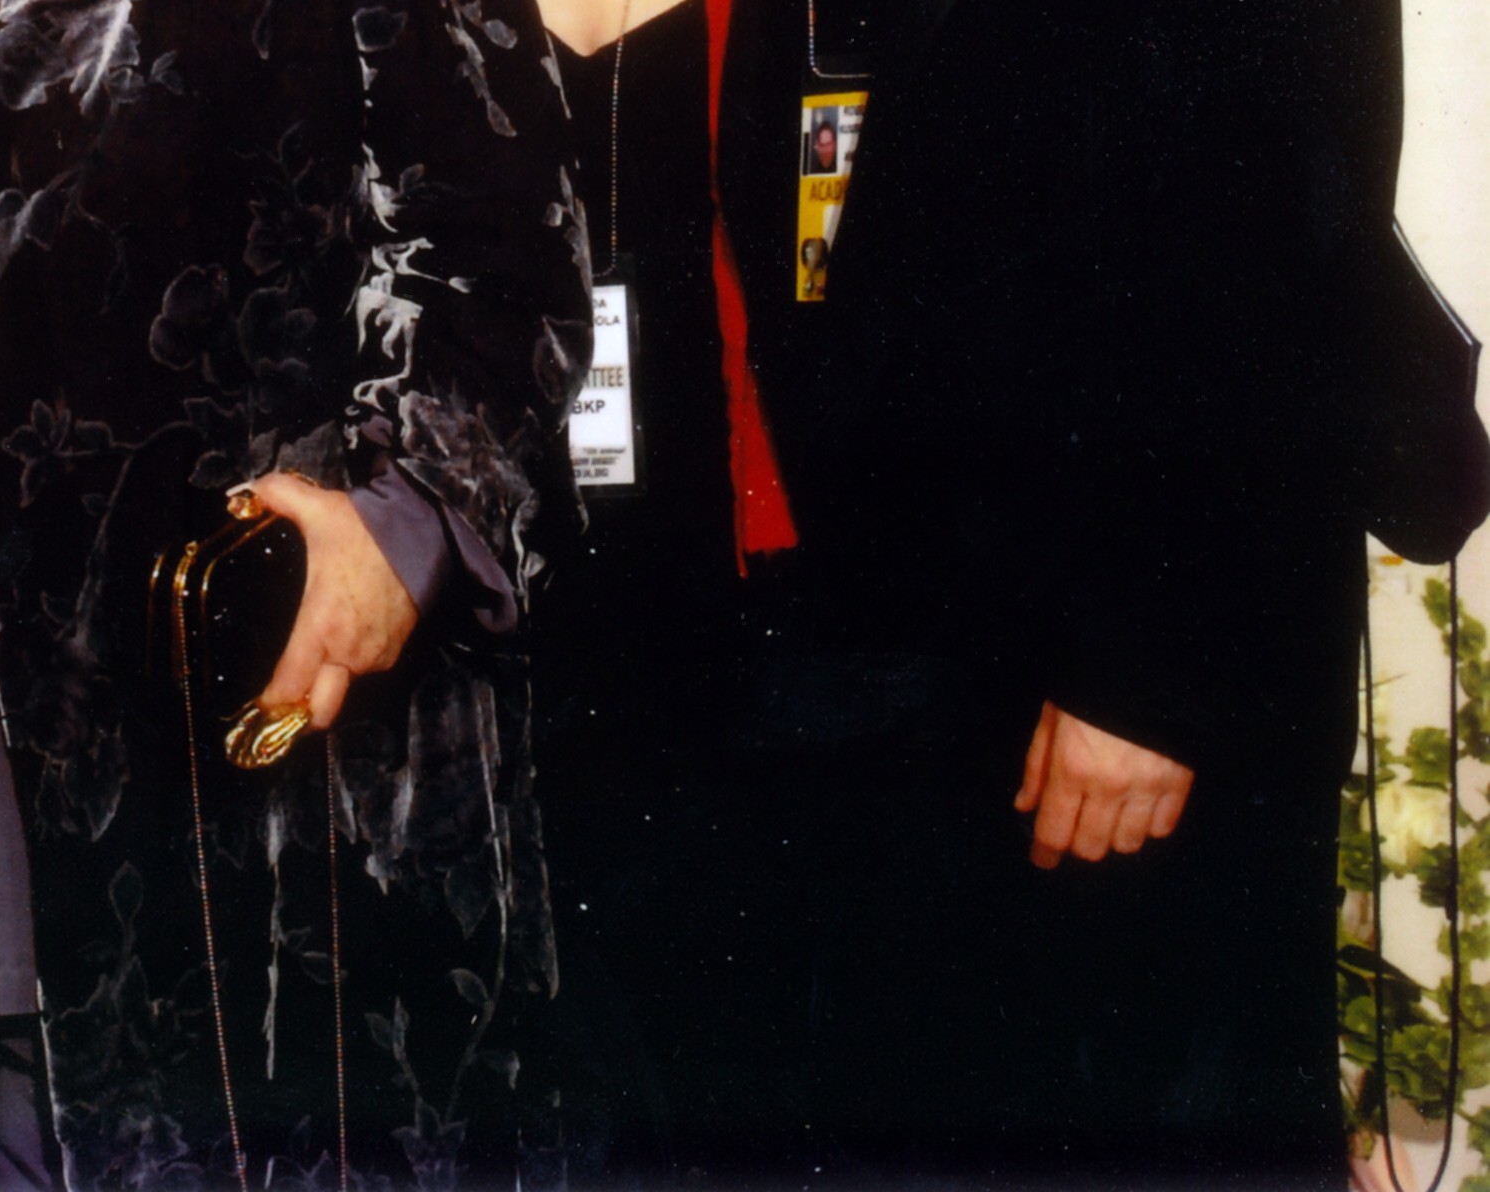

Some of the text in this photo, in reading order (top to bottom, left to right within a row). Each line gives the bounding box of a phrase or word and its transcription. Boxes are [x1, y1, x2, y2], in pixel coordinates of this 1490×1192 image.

[810, 180, 844, 202] ACAD
[594, 315, 620, 326] OLA
[572, 399, 606, 415] BKP
